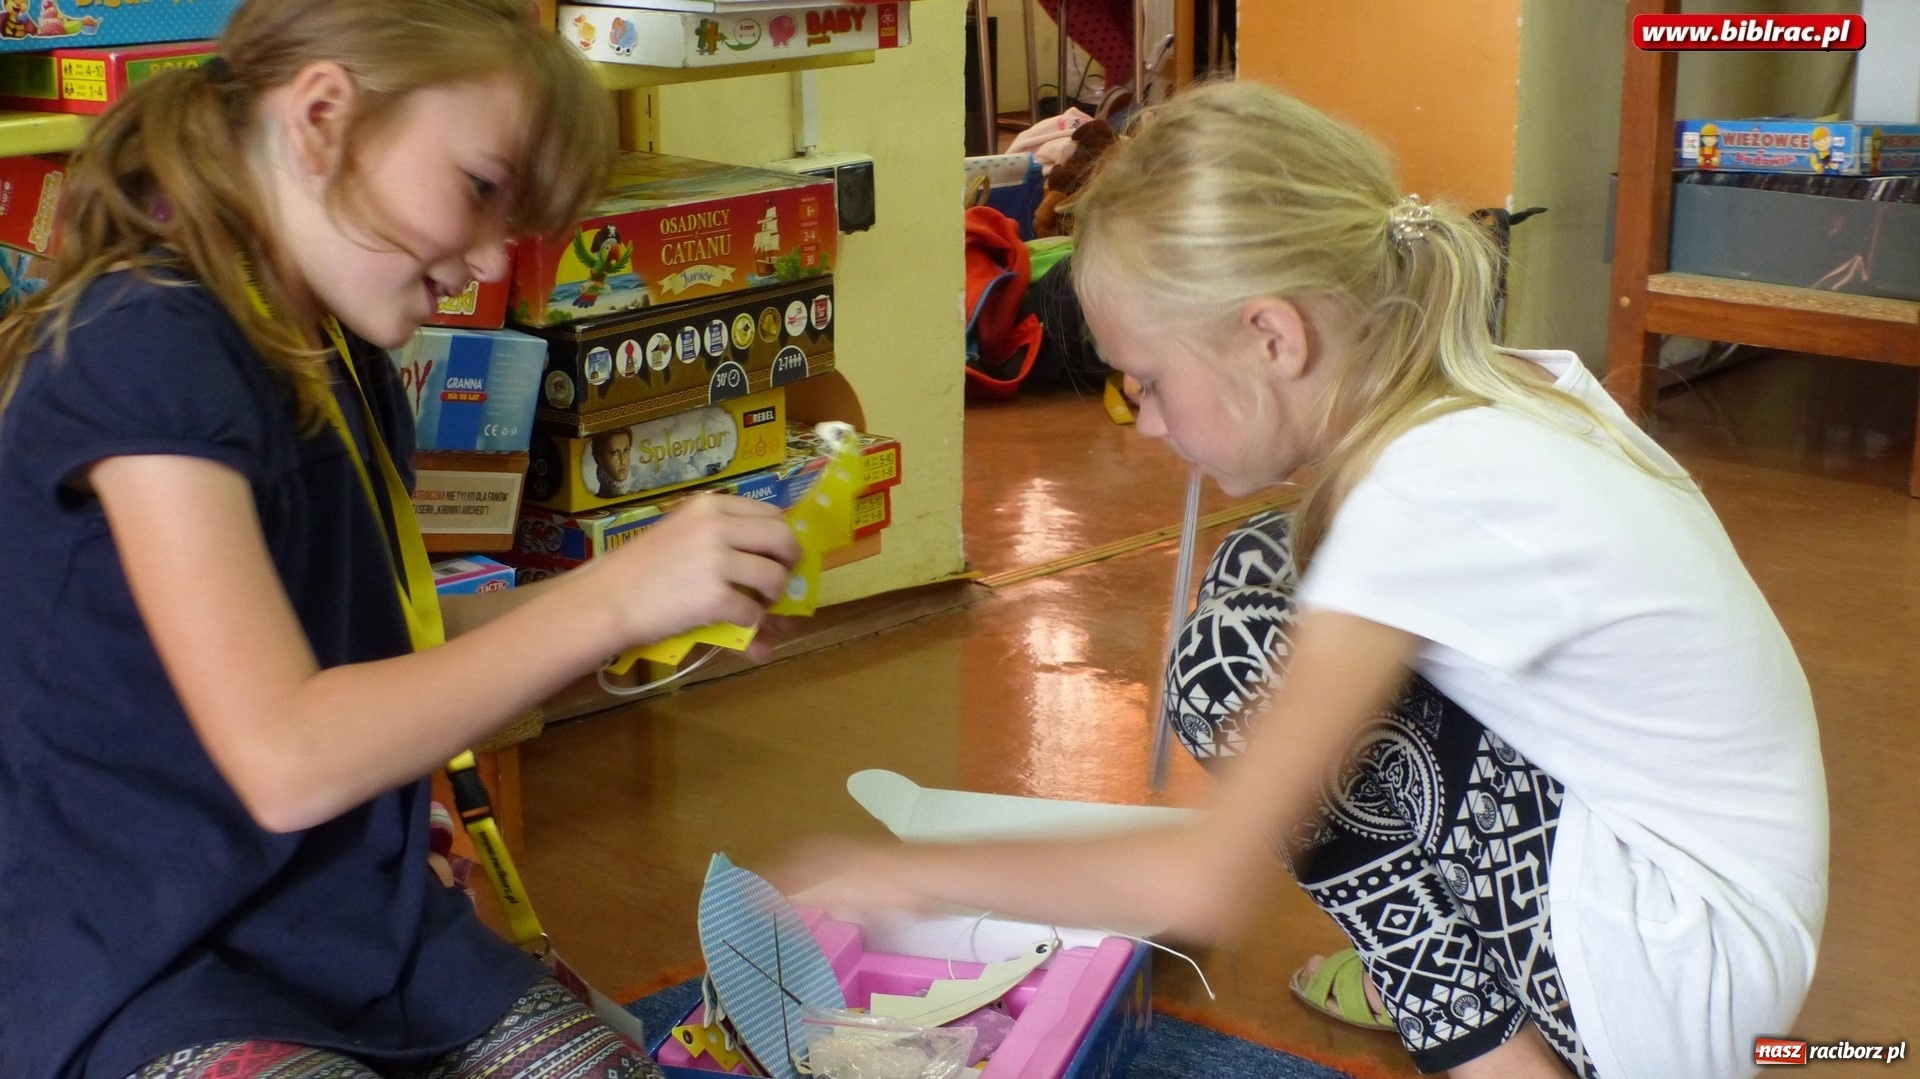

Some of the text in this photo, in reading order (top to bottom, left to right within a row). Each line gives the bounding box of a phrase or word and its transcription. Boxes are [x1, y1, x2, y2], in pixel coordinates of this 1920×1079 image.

[806, 6, 866, 36] BABY
[89, 85, 103, 97] 1-4
[660, 209, 730, 235] OSADNICY
[660, 235, 731, 266] CATANU
[680, 271, 714, 288] Junior
[447, 378, 483, 390] GRANNA
[752, 410, 775, 424] REBEL
[638, 423, 730, 475] Splendor
